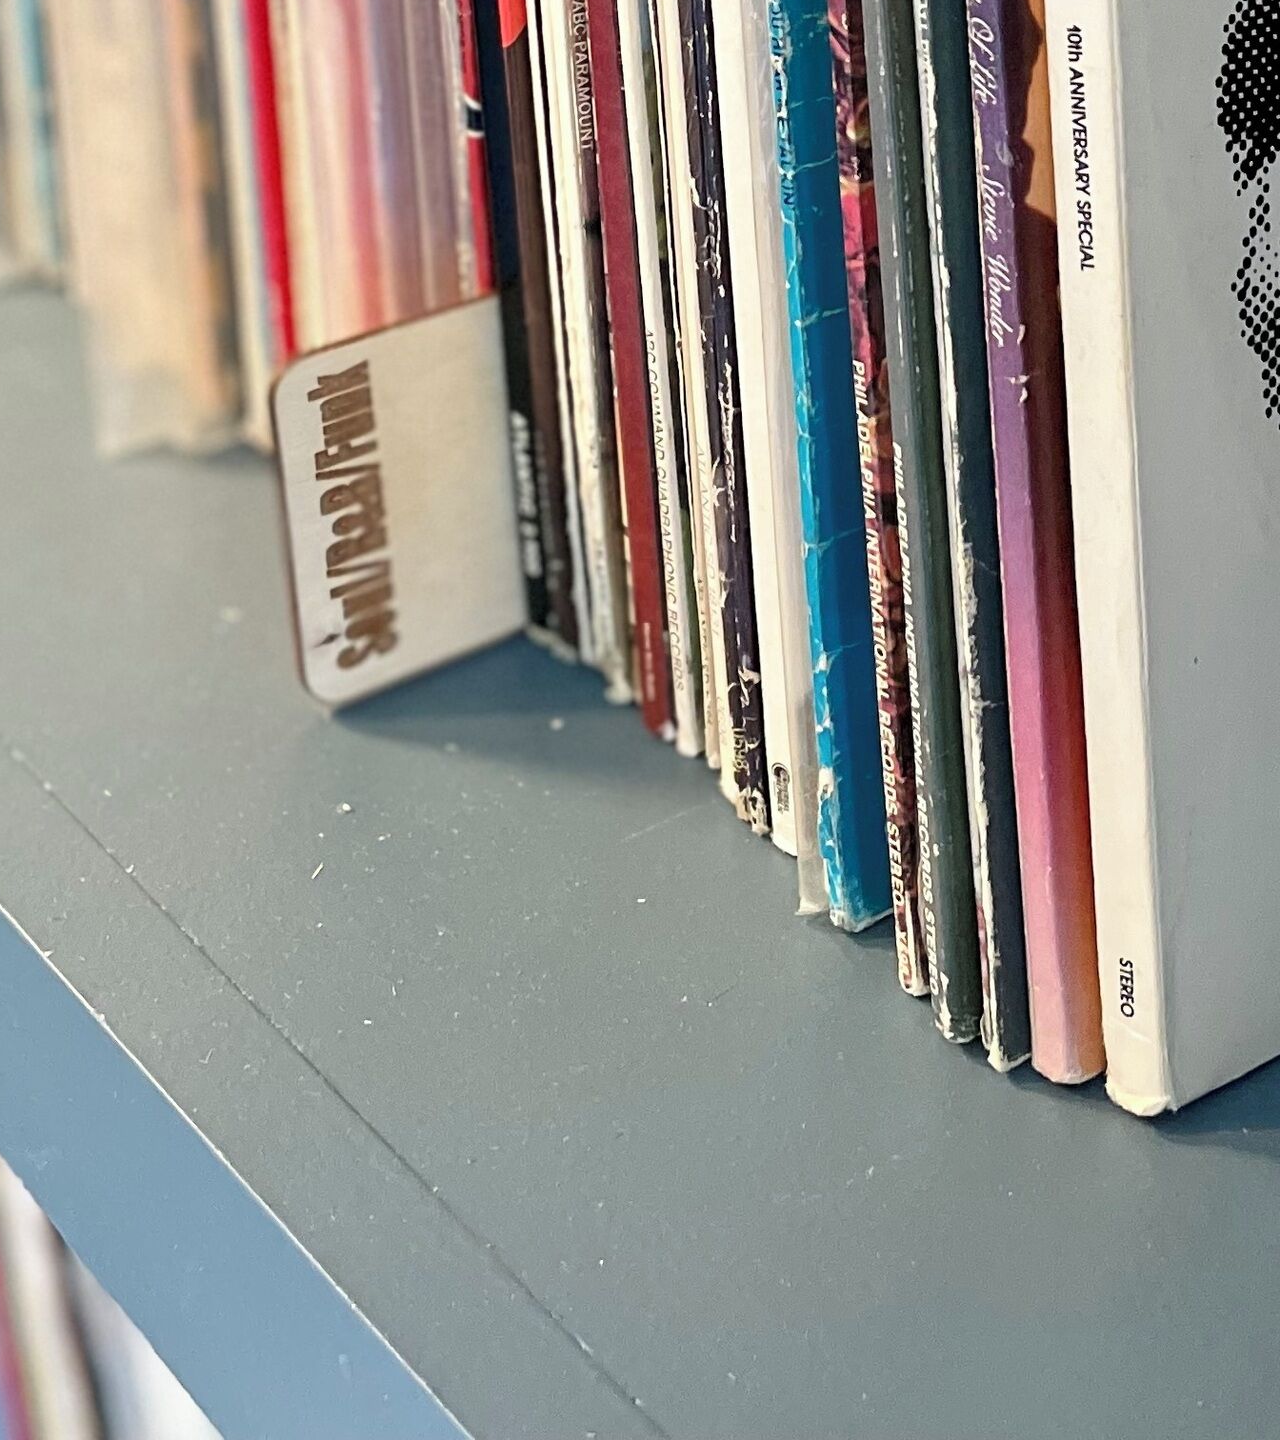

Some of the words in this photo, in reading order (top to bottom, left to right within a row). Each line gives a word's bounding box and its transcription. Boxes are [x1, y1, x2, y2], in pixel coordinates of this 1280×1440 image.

[570, 0, 596, 150] ABC-PARAMOUNT
[969, 16, 996, 58] Of
[970, 56, 999, 107] Life
[1066, 24, 1083, 59] 10th
[1068, 65, 1090, 195] ANNIVERSARY
[981, 164, 1007, 241] Stevie
[1075, 199, 1095, 271] SPECIAL
[985, 253, 1015, 348] Wonder
[851, 359, 877, 519] PHILADELPHIA
[306, 359, 400, 672] Soul/R&B/Funk
[650, 368, 665, 459] COMMAND
[658, 464, 677, 604] QUADRAPHONIC
[669, 609, 684, 690] RECORDS
[865, 526, 889, 700] INTERNATIONAL
[877, 708, 897, 815] RECORDS
[891, 440, 913, 605] PHILADELPHIA
[904, 611, 925, 786] INTERNATIONAL
[916, 793, 934, 902] RECORDS
[925, 906, 940, 996] STEREO
[886, 820, 904, 907] STEREO
[1117, 956, 1135, 1017] STEREO
